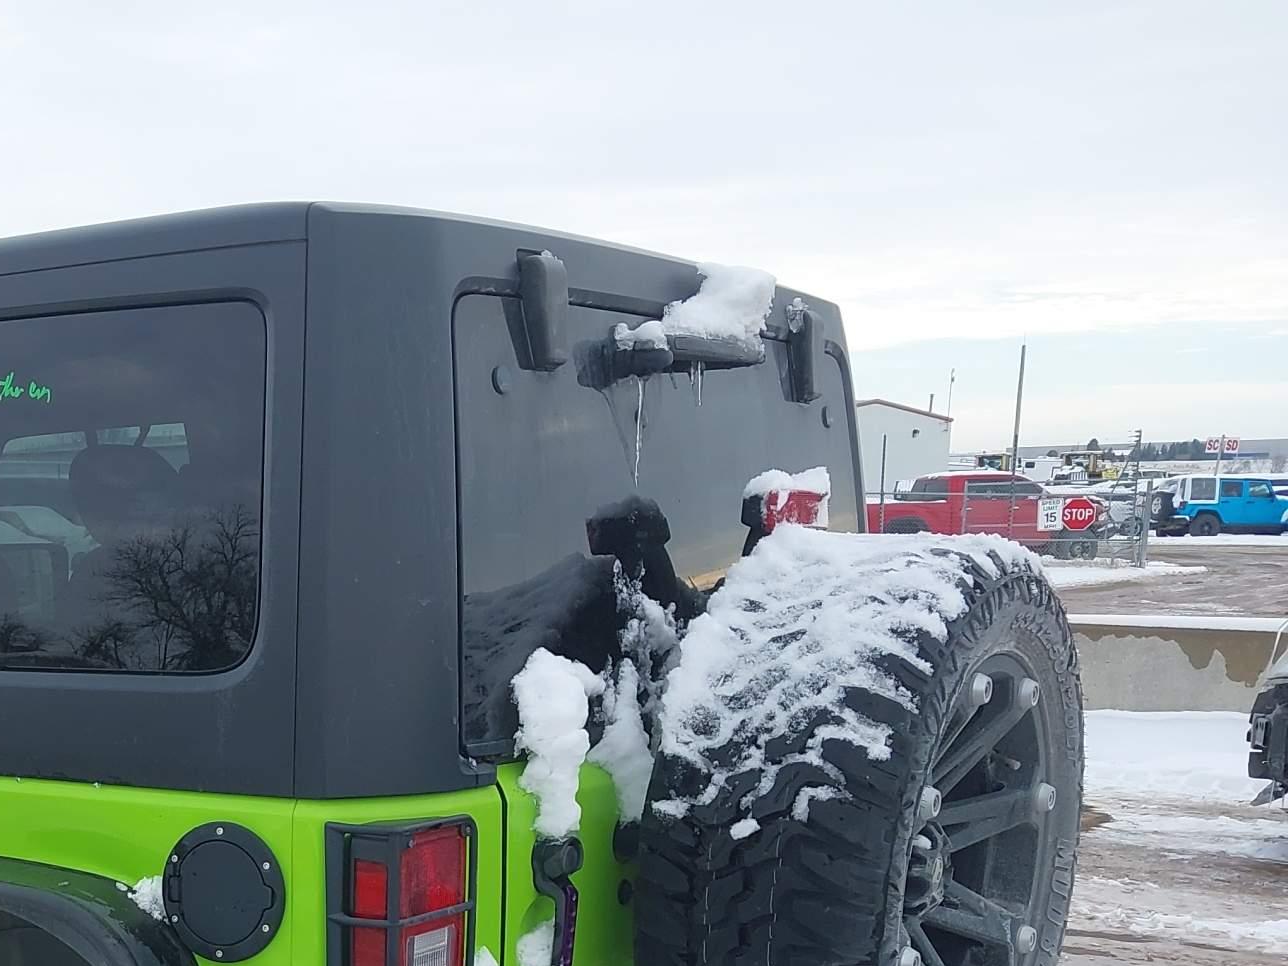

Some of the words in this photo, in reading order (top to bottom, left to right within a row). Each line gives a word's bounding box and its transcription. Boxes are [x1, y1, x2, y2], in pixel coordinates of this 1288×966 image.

[1206, 439, 1220, 451] SC
[1225, 439, 1239, 451] SD
[1044, 511, 1057, 523] 15
[1063, 508, 1094, 521] STOP
